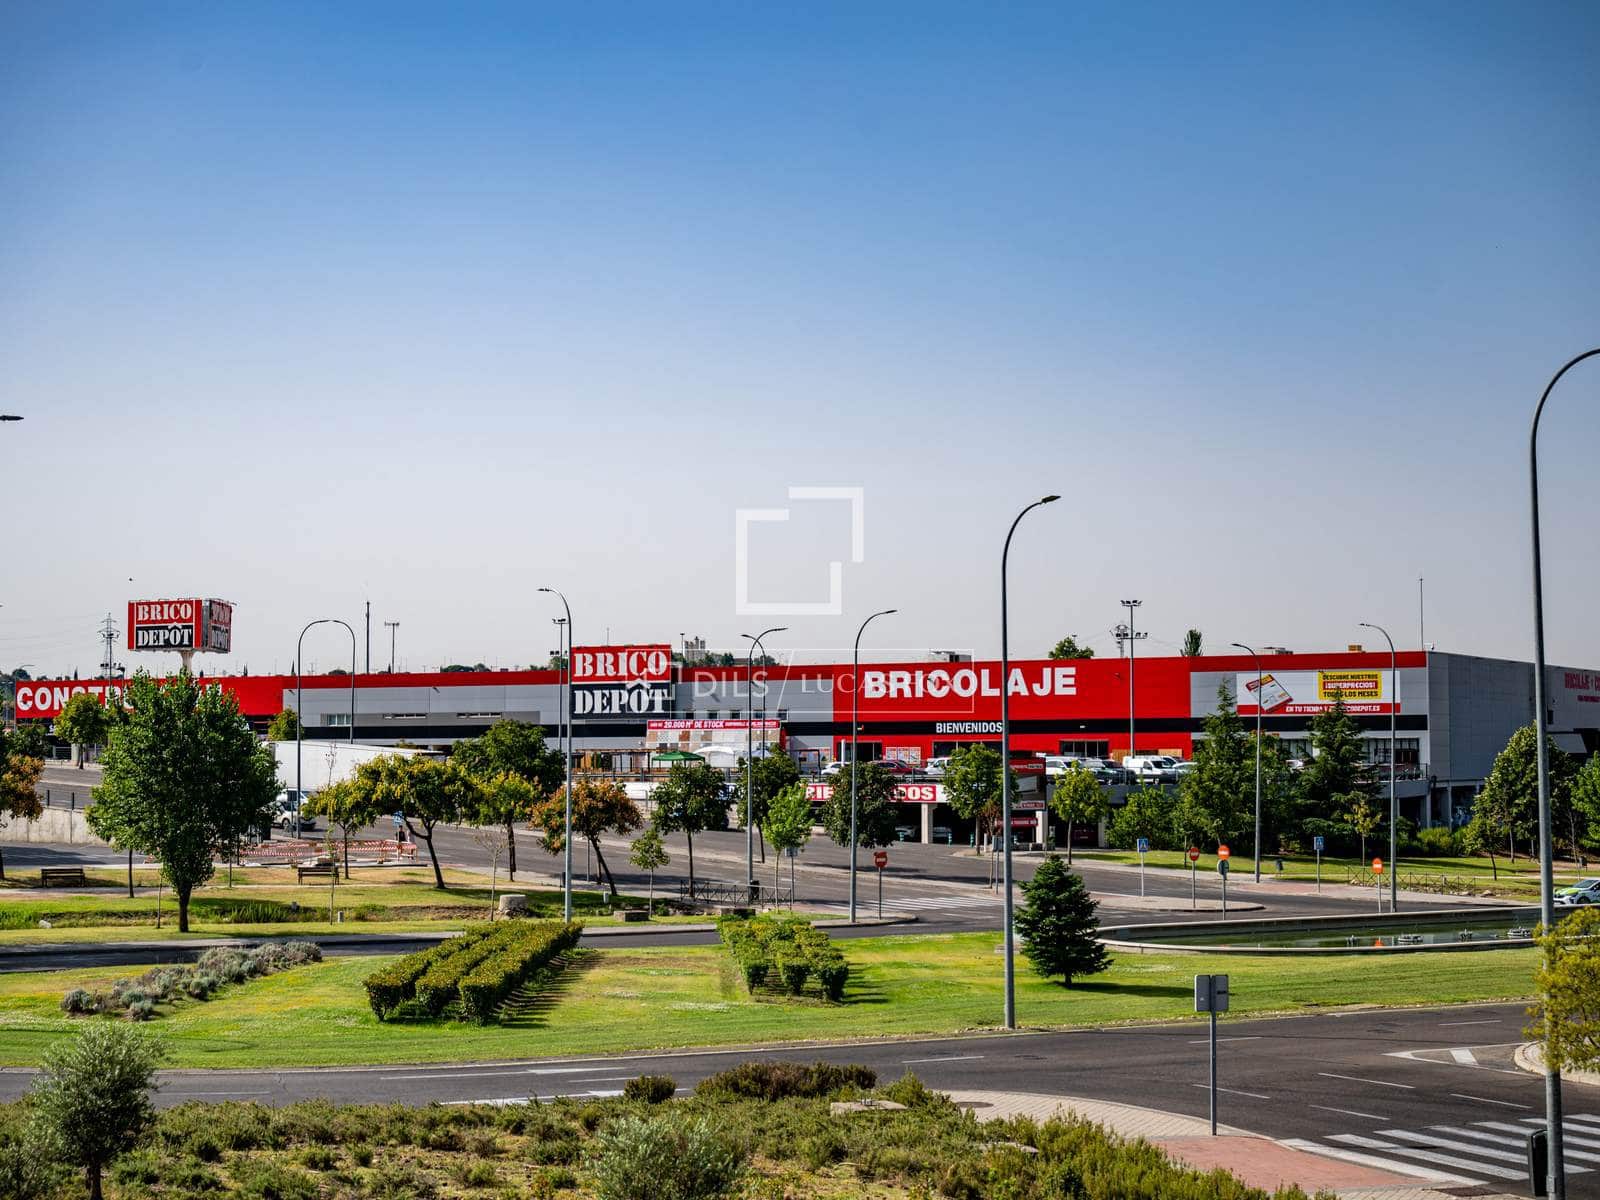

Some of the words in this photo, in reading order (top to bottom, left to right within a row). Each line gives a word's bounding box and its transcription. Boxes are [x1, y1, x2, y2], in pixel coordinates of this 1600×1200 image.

[137, 603, 192, 621] BRICO
[573, 651, 667, 677] BRICO
[864, 666, 1077, 699] BRICOLAJE
[573, 678, 669, 714] DEPÔT
[695, 721, 703, 729] DE
[704, 720, 724, 729] STOCK
[936, 722, 1003, 734] BIENVENIDOS
